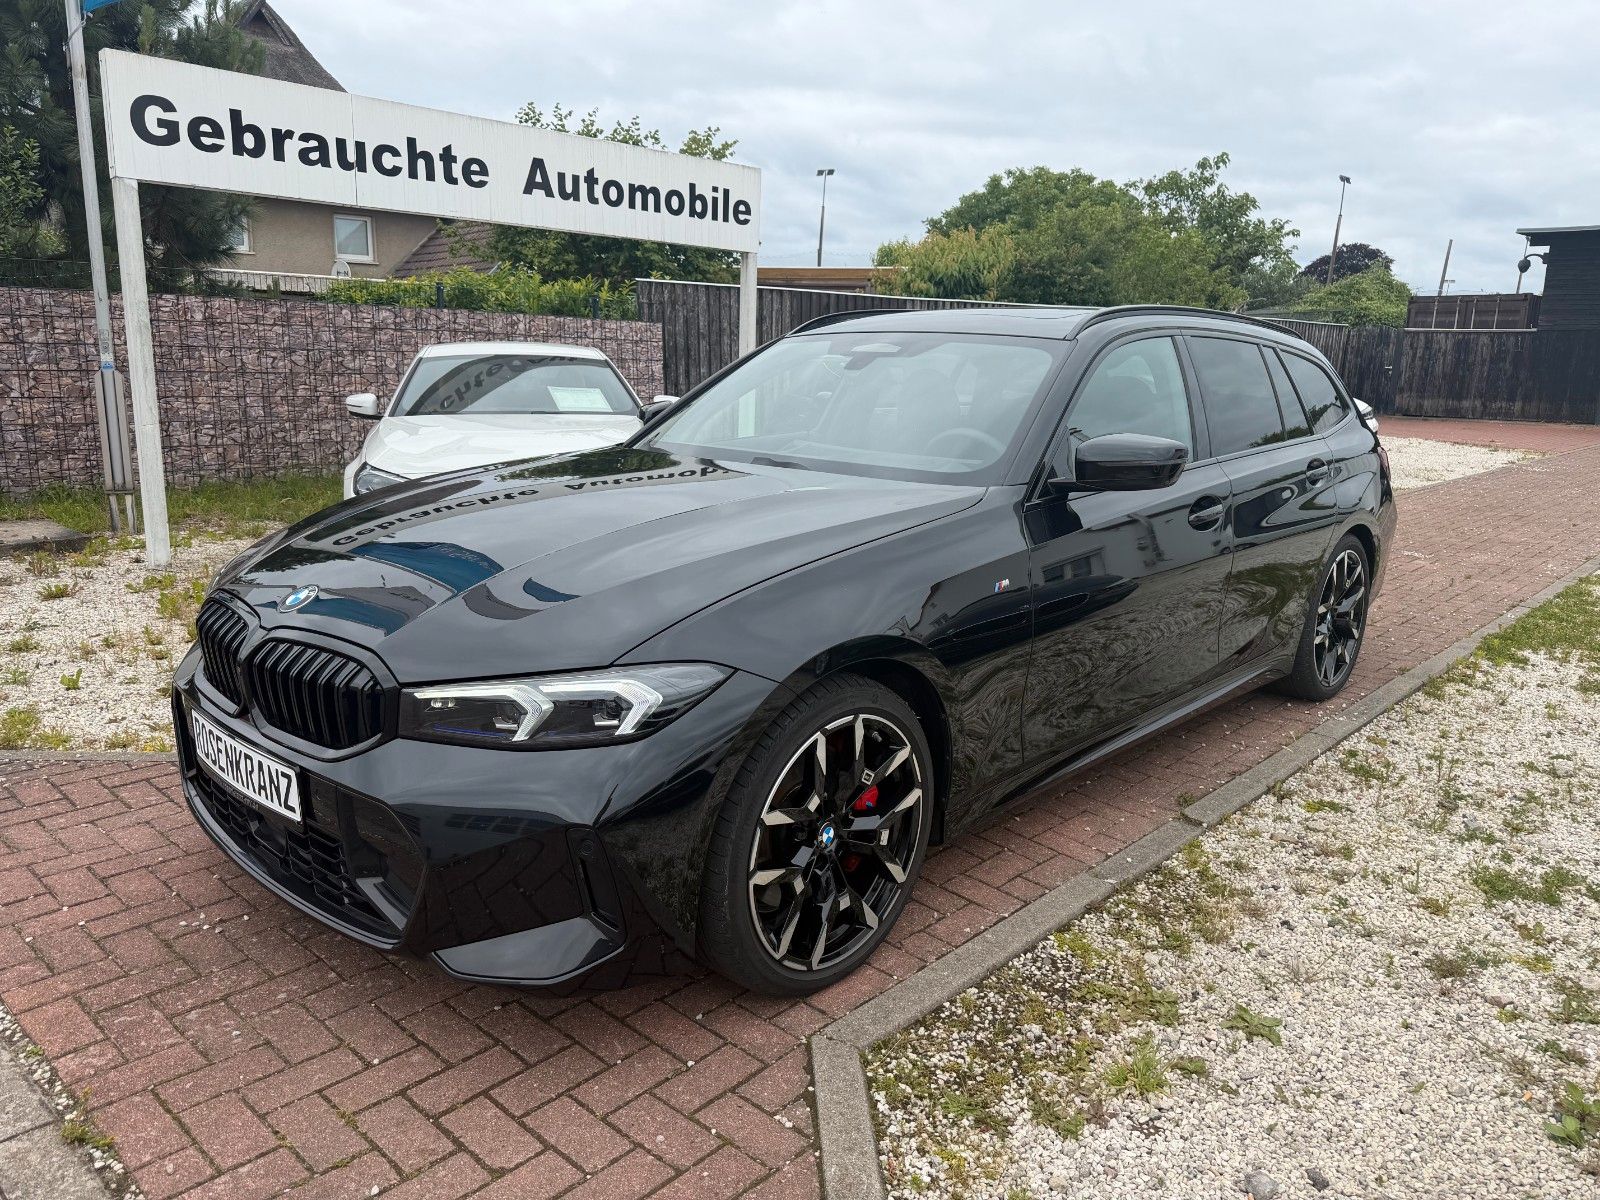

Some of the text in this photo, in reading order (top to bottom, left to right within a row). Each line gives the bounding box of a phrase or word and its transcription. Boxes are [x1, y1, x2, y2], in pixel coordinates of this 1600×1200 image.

[129, 94, 752, 225] Gebrauchte Automobile
[194, 715, 297, 814] ROSENKRANZ
